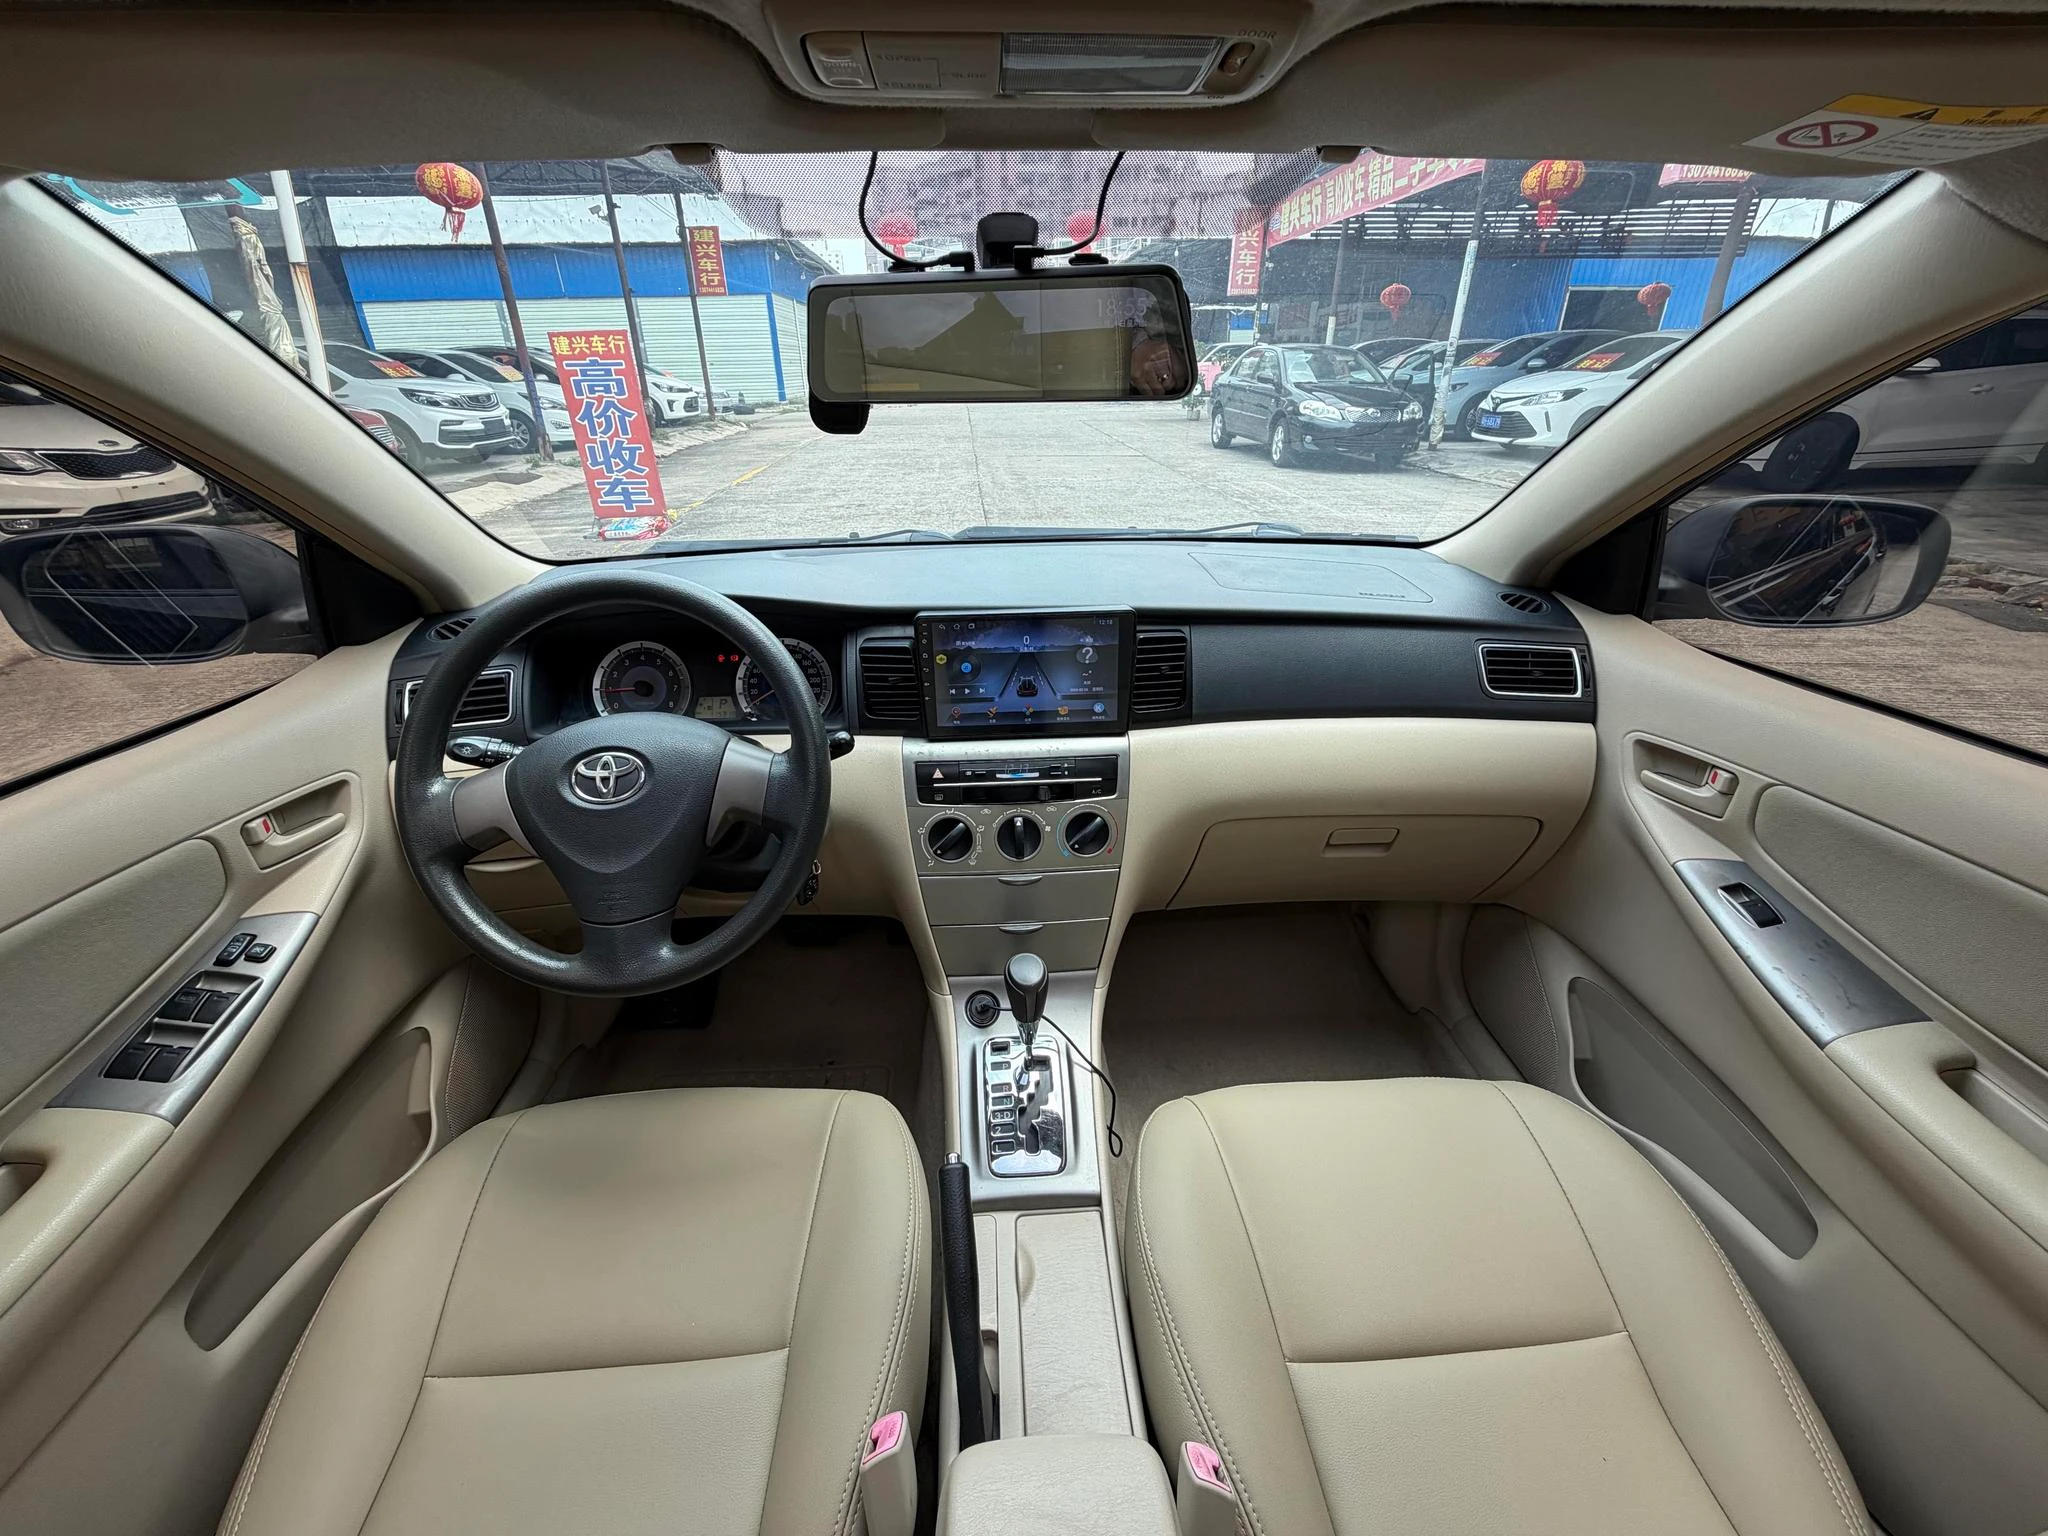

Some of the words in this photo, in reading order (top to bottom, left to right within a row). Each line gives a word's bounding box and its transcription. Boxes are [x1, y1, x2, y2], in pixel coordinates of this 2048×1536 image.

[692, 229, 721, 286] 建兴车行
[1235, 226, 1260, 286] 兴车行
[552, 335, 626, 355] 建兴车行
[562, 357, 655, 513] 高价收车
[719, 698, 728, 708] P
[994, 1111, 1011, 1120] 3-D
[994, 1126, 1001, 1135] 2
[995, 1144, 1002, 1153] L
